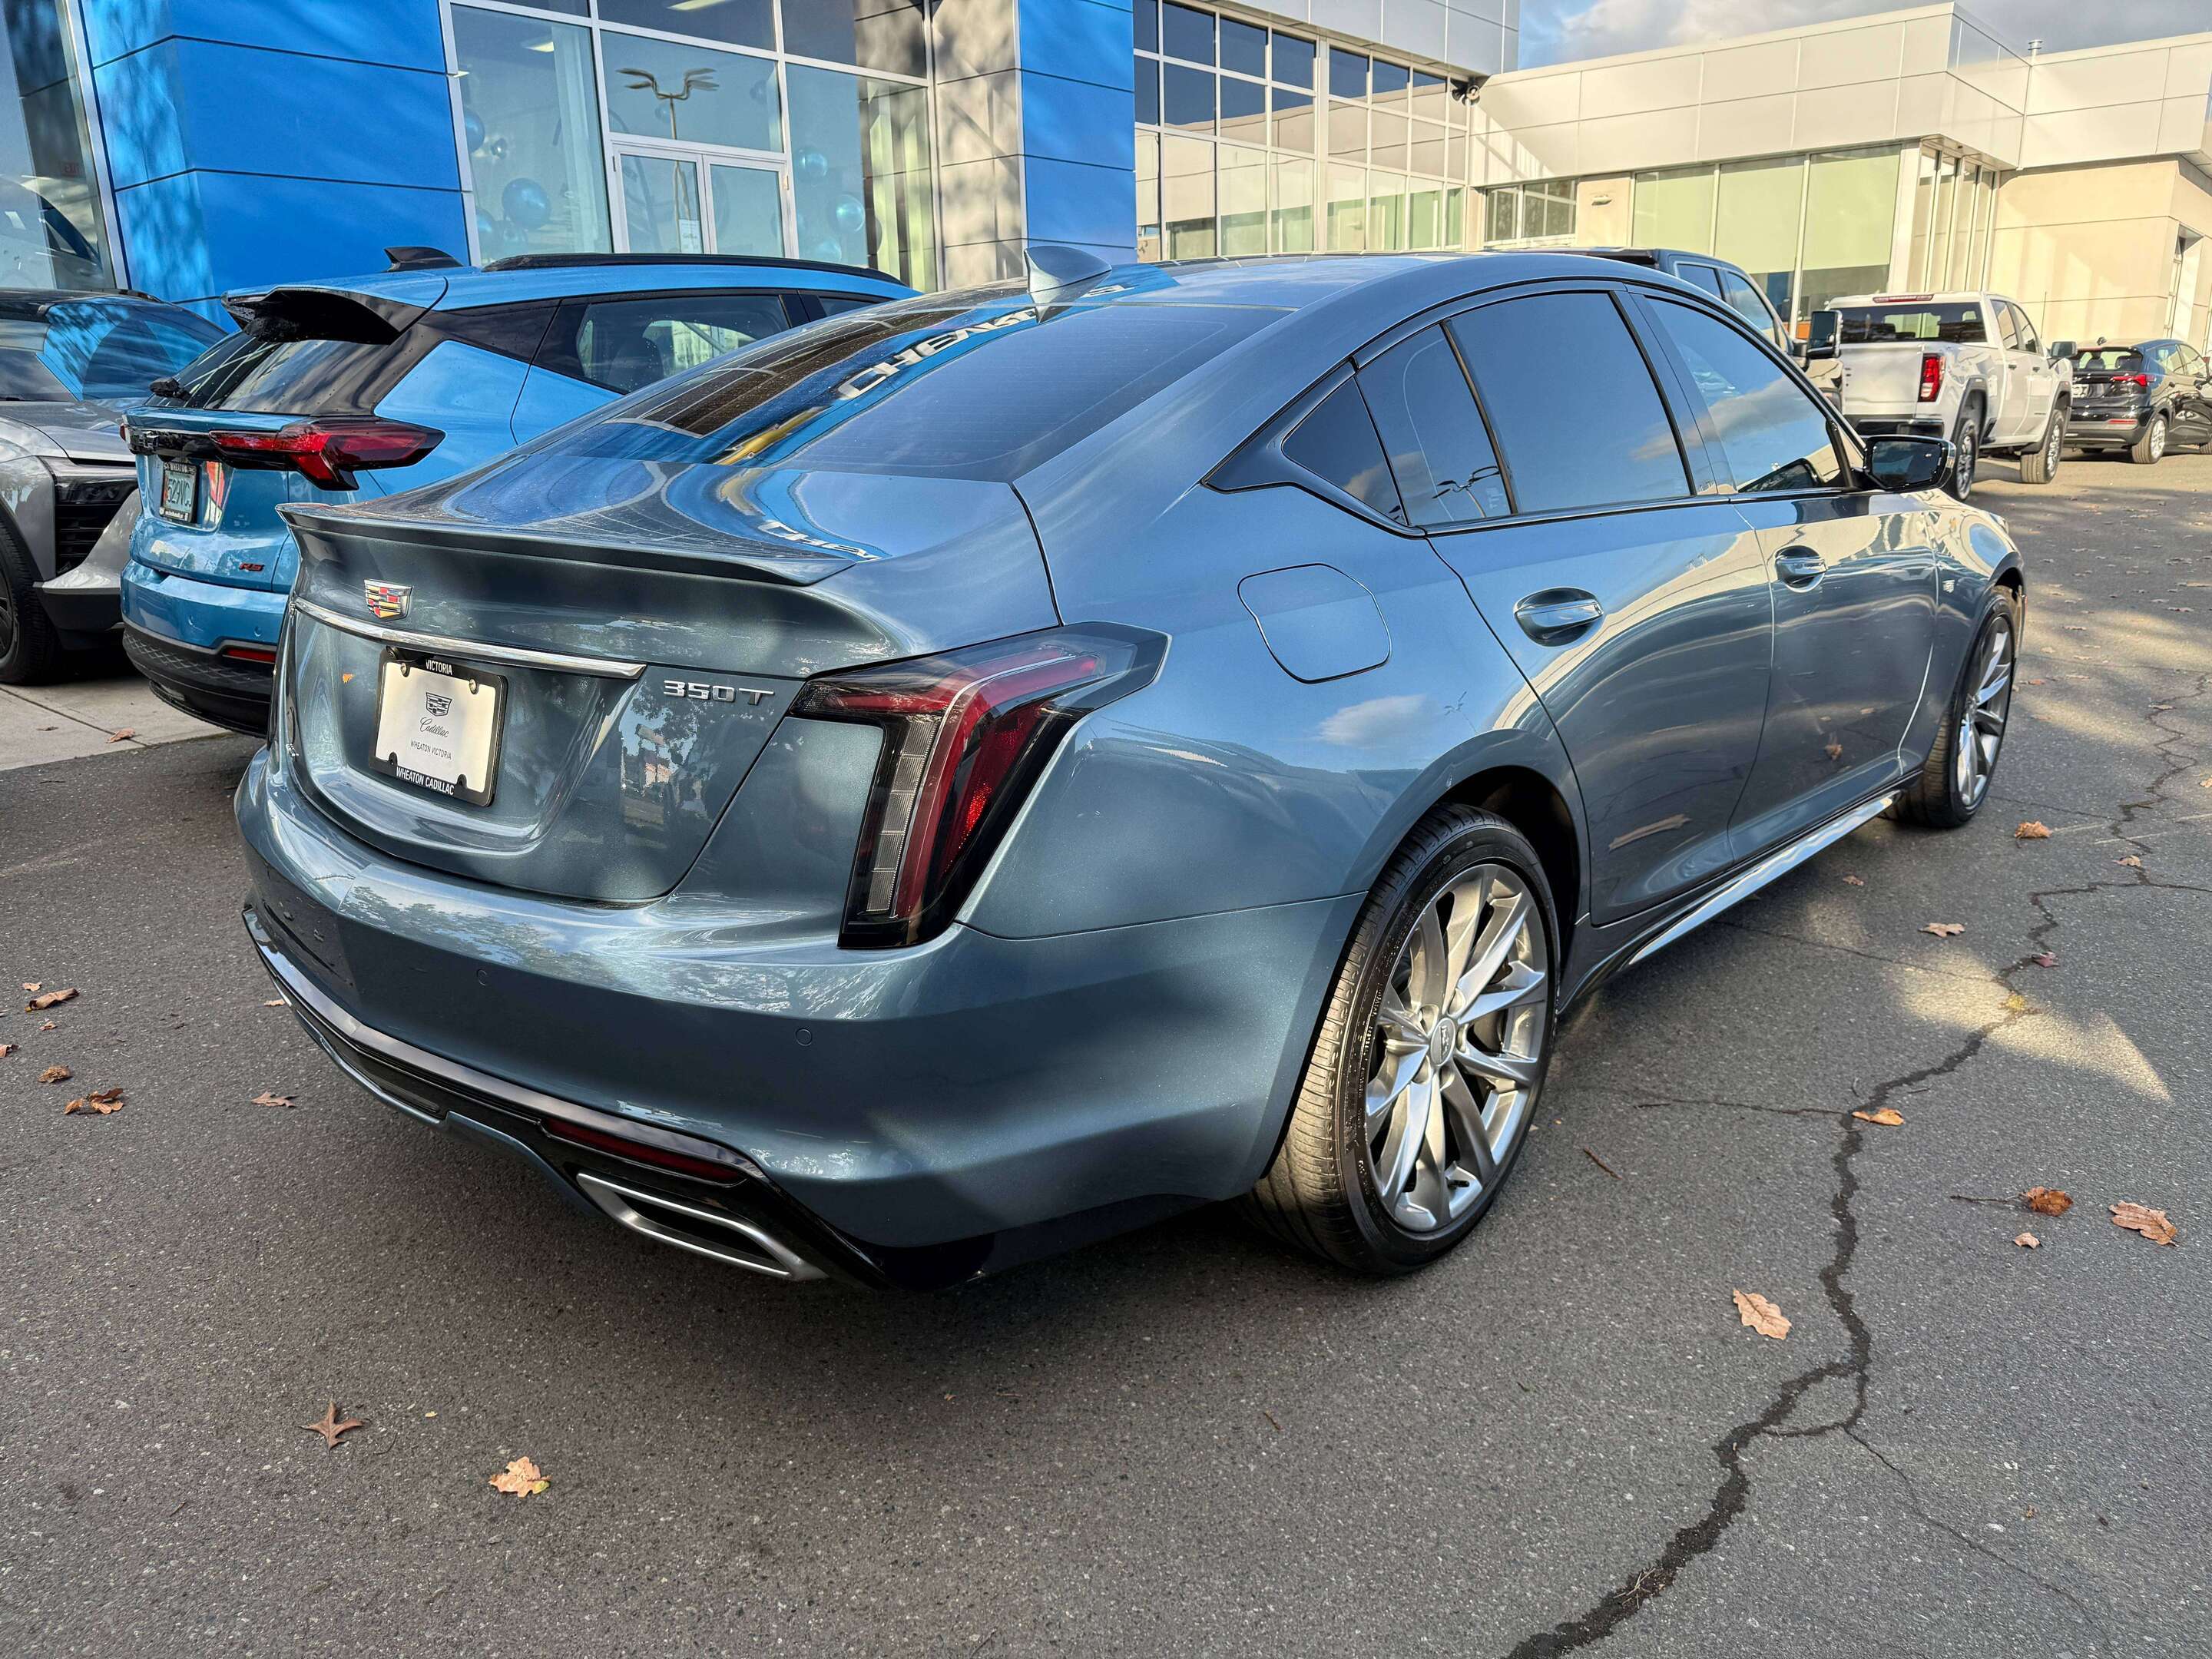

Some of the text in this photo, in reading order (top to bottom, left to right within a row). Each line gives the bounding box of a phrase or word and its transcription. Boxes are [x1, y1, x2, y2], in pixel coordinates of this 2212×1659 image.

[239, 562, 265, 571] RS
[426, 659, 453, 676] VICTORIA
[419, 717, 449, 738] Cadillac
[410, 740, 452, 760] WHEATON VICTORIA
[396, 767, 455, 796] WHEATON CADILLAC
